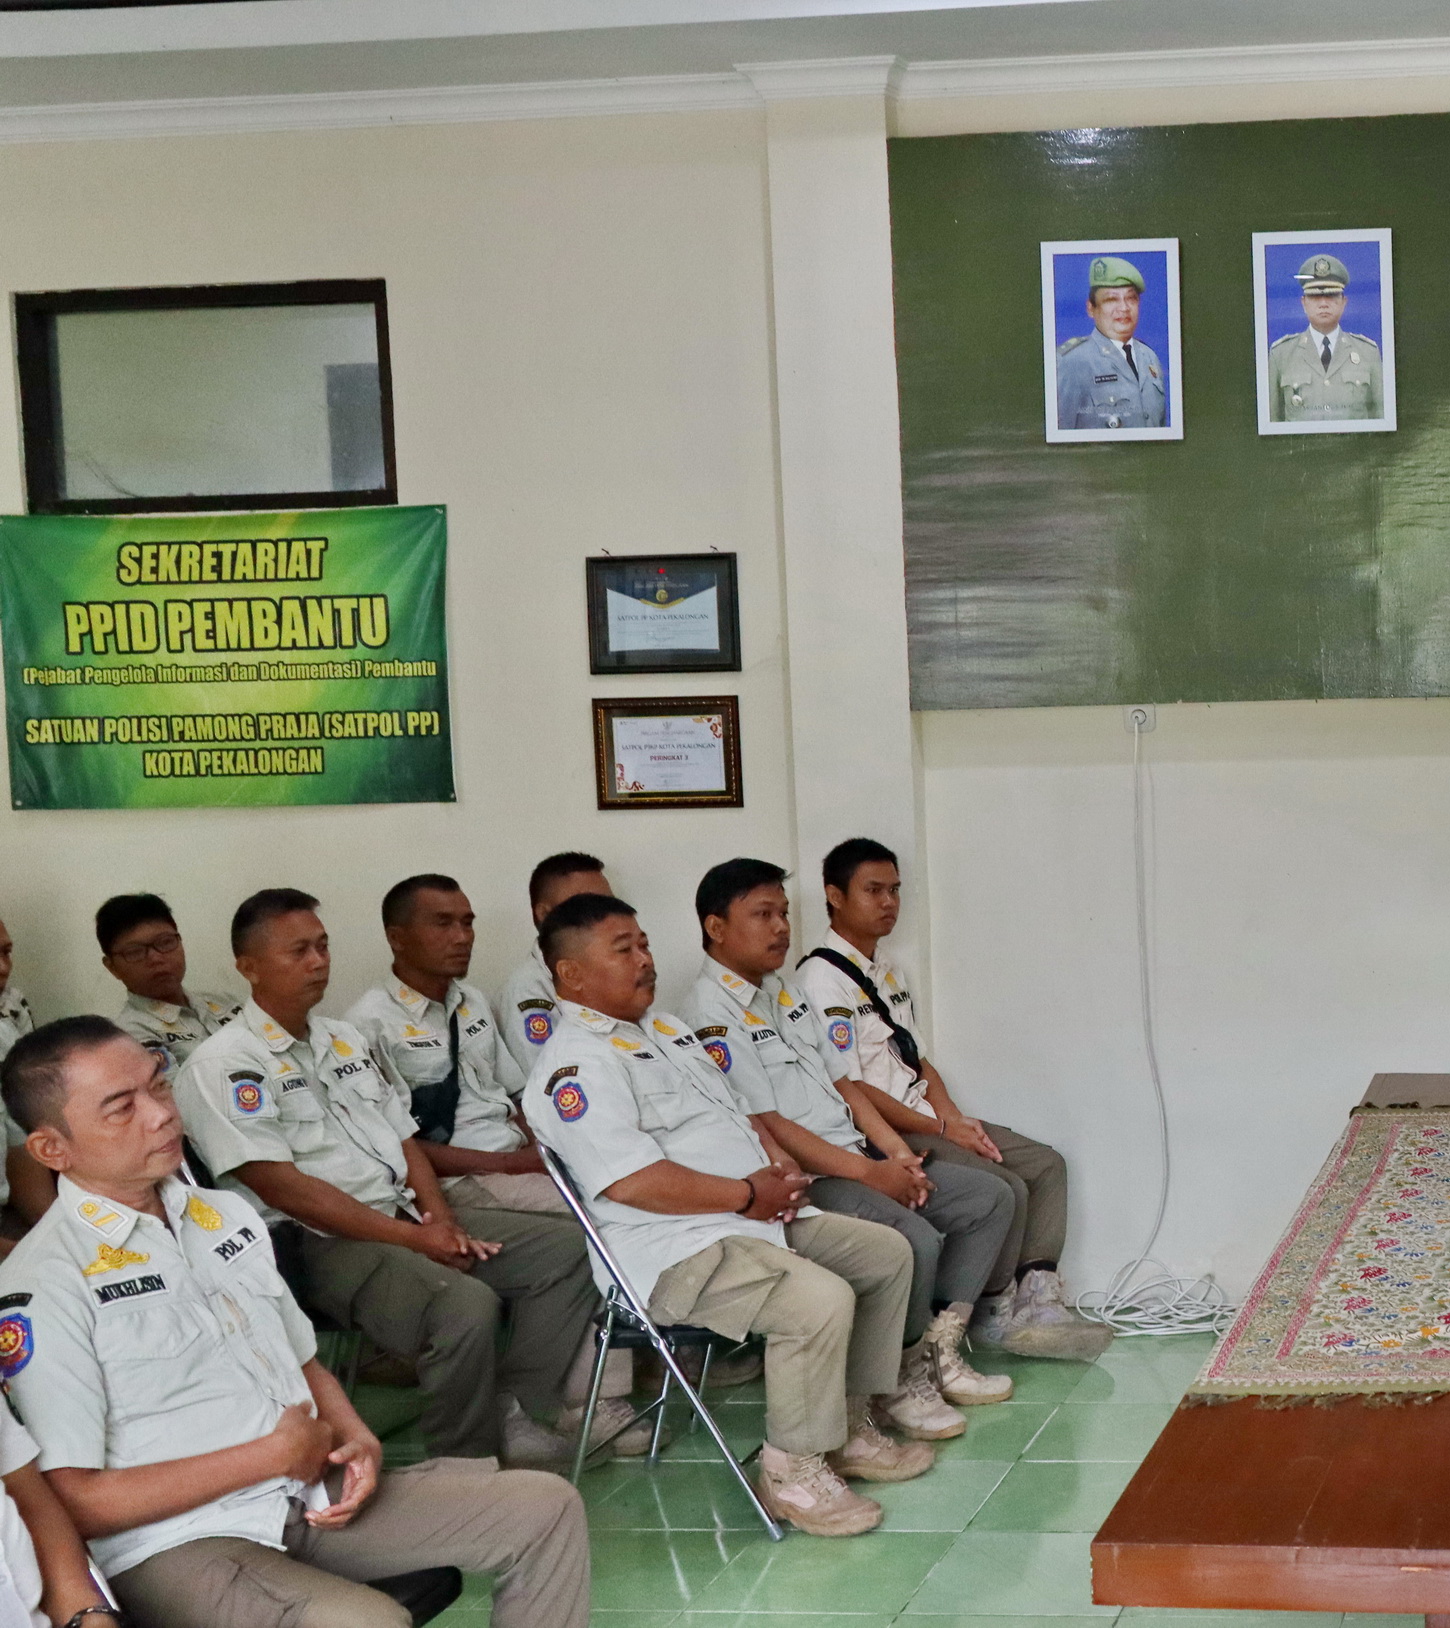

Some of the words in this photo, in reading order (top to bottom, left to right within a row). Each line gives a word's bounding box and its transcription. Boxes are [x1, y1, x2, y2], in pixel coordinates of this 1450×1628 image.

[117, 538, 328, 586] SEKRETARIAT
[63, 601, 158, 655] PPID
[165, 594, 390, 653] PEMBANTU
[23, 666, 82, 686] (Pejabat
[84, 665, 156, 686] Pengelola
[157, 663, 228, 684] Informasi
[229, 662, 258, 682] dan
[259, 661, 362, 682] Dokumentasi)
[363, 660, 437, 678] Pembantu
[25, 718, 100, 745] SATUAN
[103, 717, 168, 743] POLISI
[171, 714, 255, 742] PAMONG
[258, 713, 321, 740] PRAJA
[323, 712, 404, 739] (SATPOL
[406, 710, 440, 737] PP)
[143, 750, 197, 778] KOTA
[199, 748, 323, 777] PEKALONGAN
[333, 1062, 361, 1080] POL
[361, 1058, 371, 1069] P
[214, 1238, 244, 1261] POL
